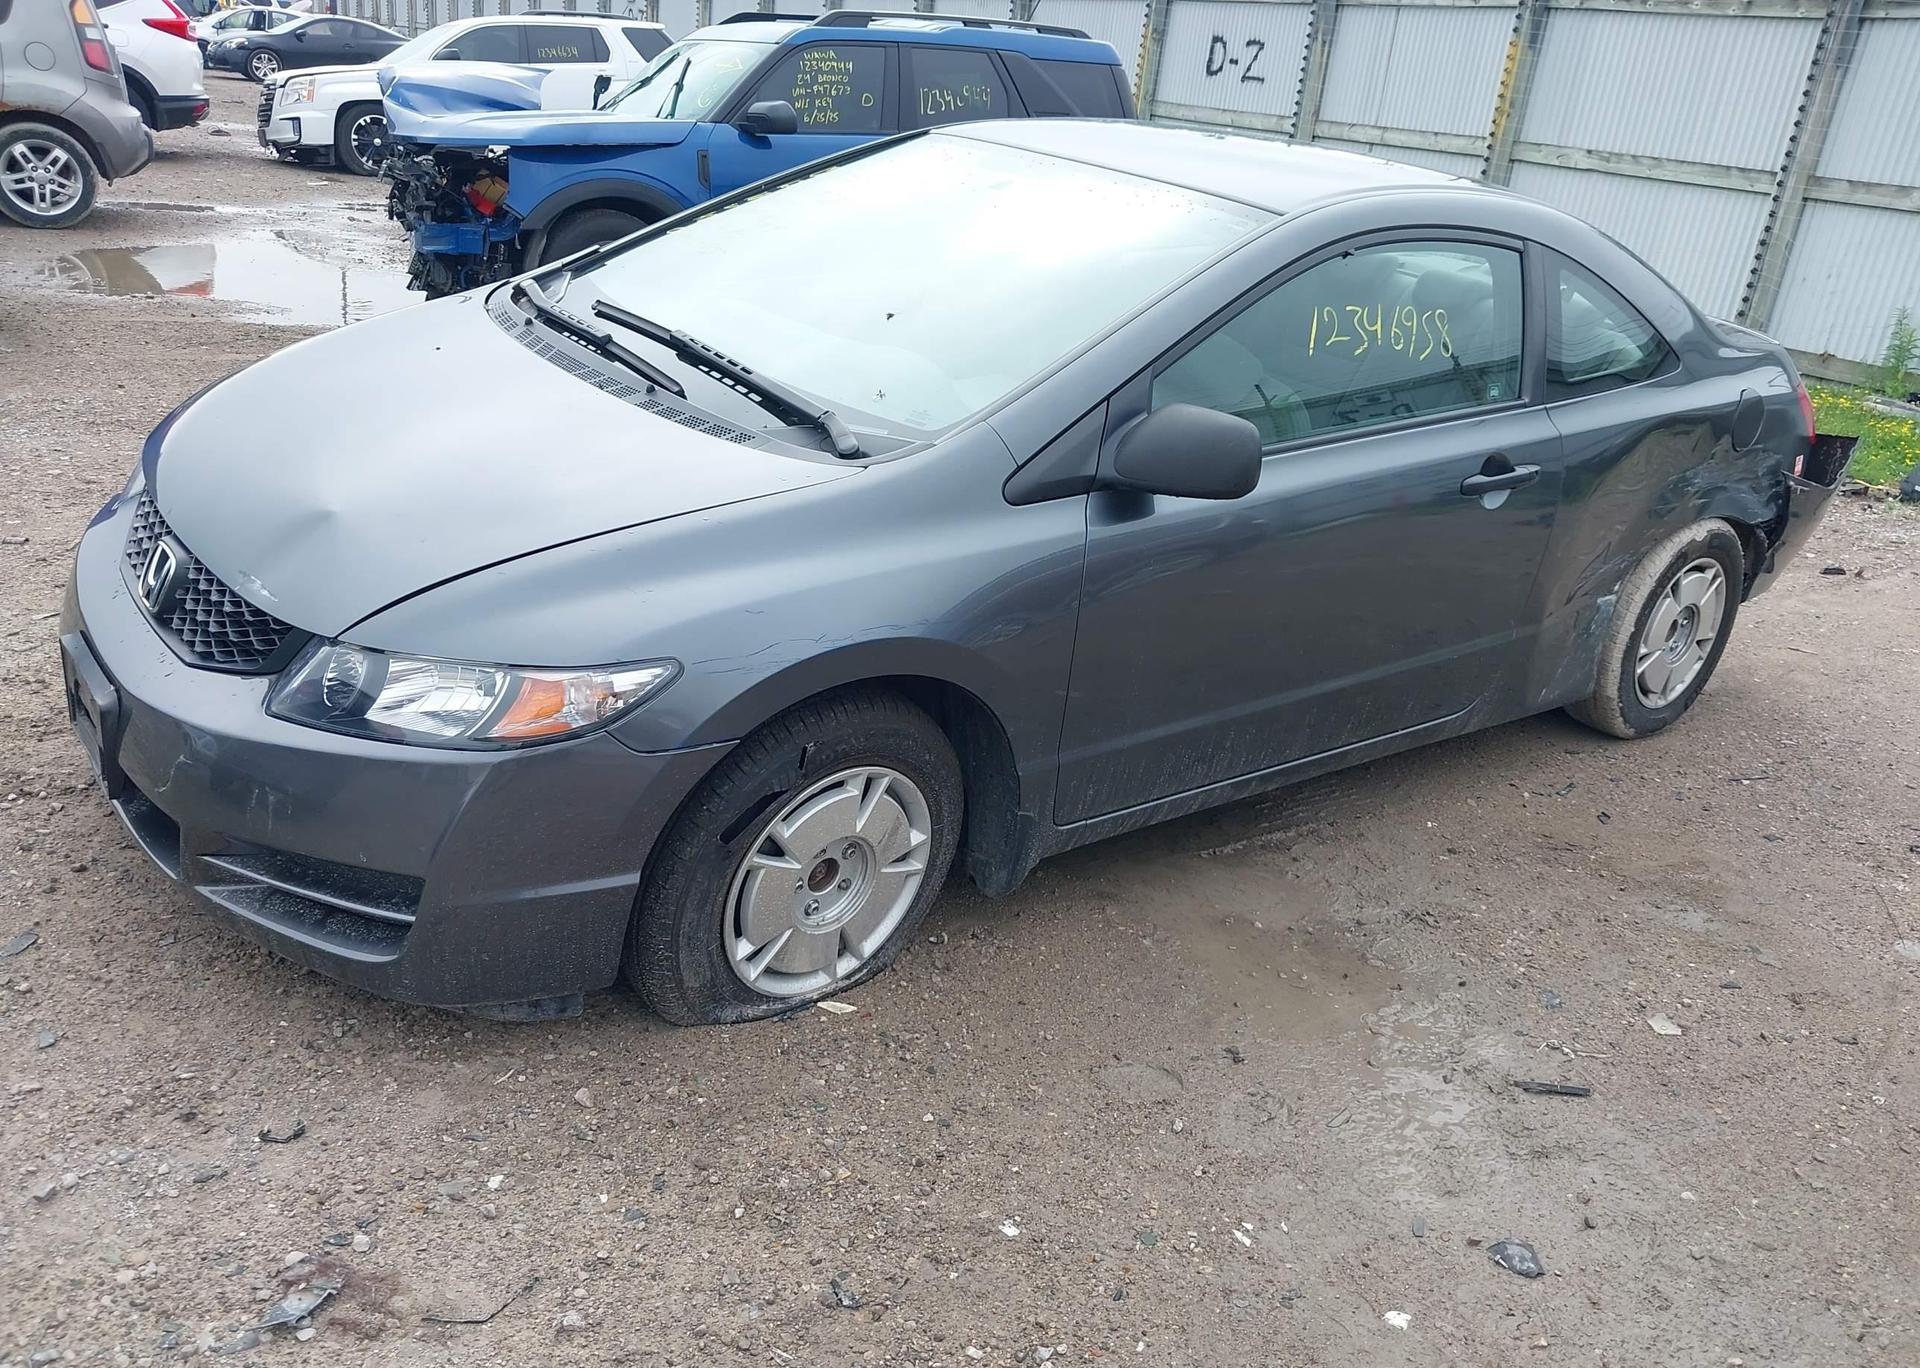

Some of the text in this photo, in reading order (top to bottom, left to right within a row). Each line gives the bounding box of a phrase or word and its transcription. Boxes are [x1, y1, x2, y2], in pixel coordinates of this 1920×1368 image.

[803, 49, 837, 60] WAWA
[800, 60, 853, 74] 12340944
[817, 74, 849, 82] BRONCO
[815, 97, 833, 109] KEY
[803, 108, 839, 125] 6/25/25
[1309, 303, 1452, 361] 12346958
